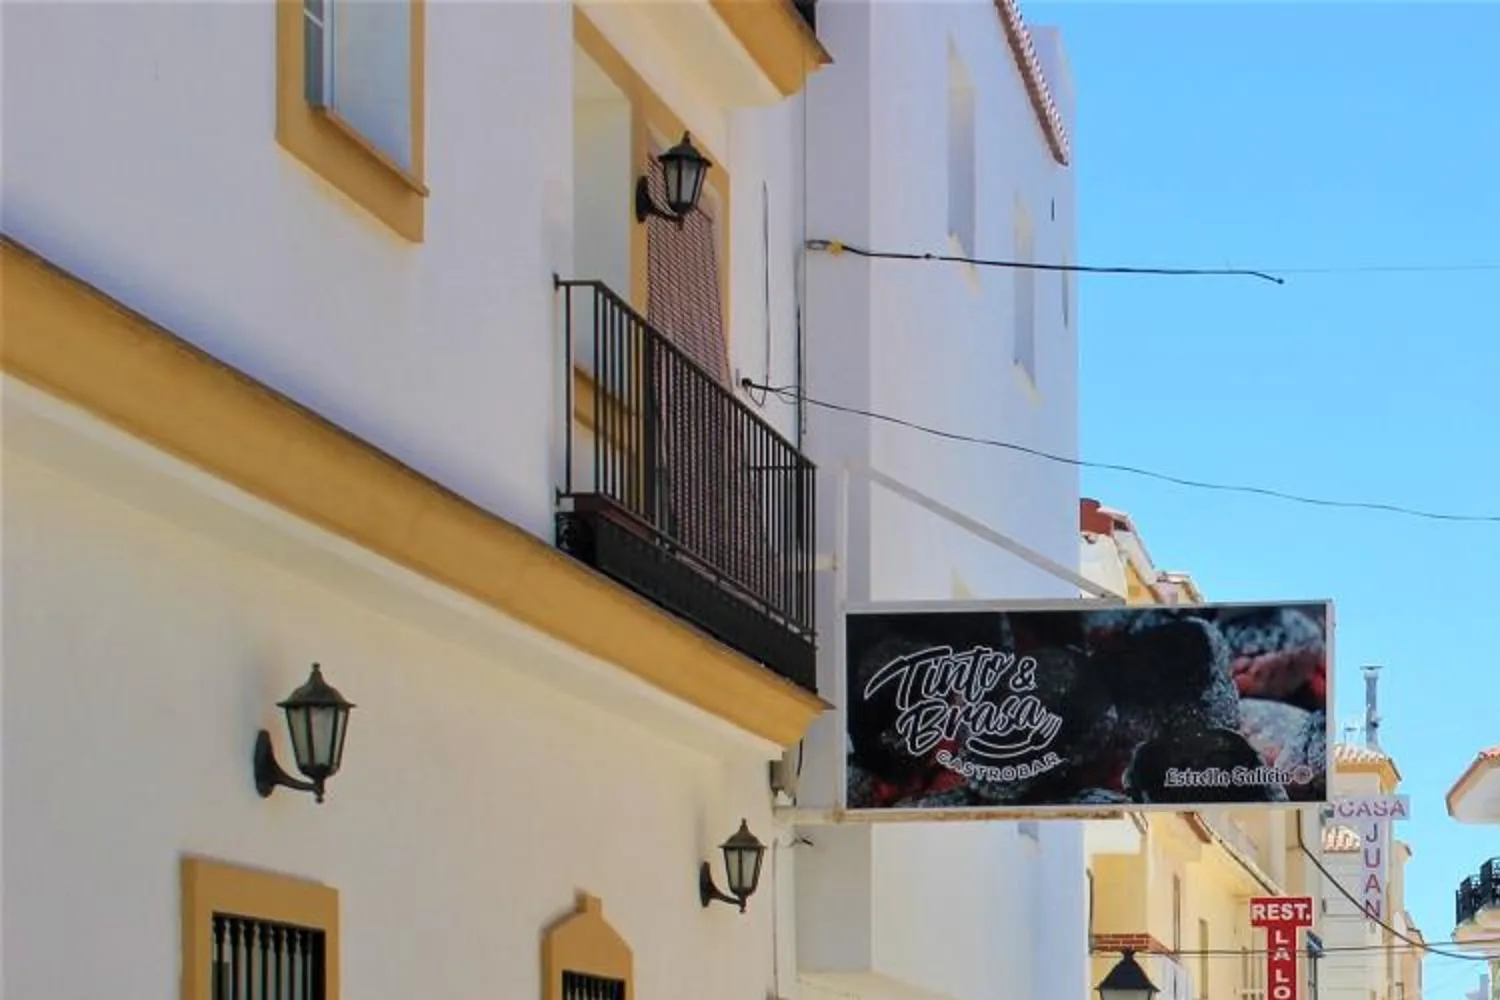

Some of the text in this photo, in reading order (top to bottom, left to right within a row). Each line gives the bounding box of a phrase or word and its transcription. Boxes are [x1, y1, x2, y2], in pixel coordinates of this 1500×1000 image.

[864, 646, 1038, 710] Tinto &
[896, 696, 1047, 756] Brasa
[936, 750, 1064, 781] GASTROBAR
[1164, 765, 1293, 787] Estrella Galicia
[1338, 799, 1406, 817] CASA
[1364, 823, 1381, 918] JUAN
[1251, 903, 1312, 921] REST.
[1273, 929, 1291, 961] LA
